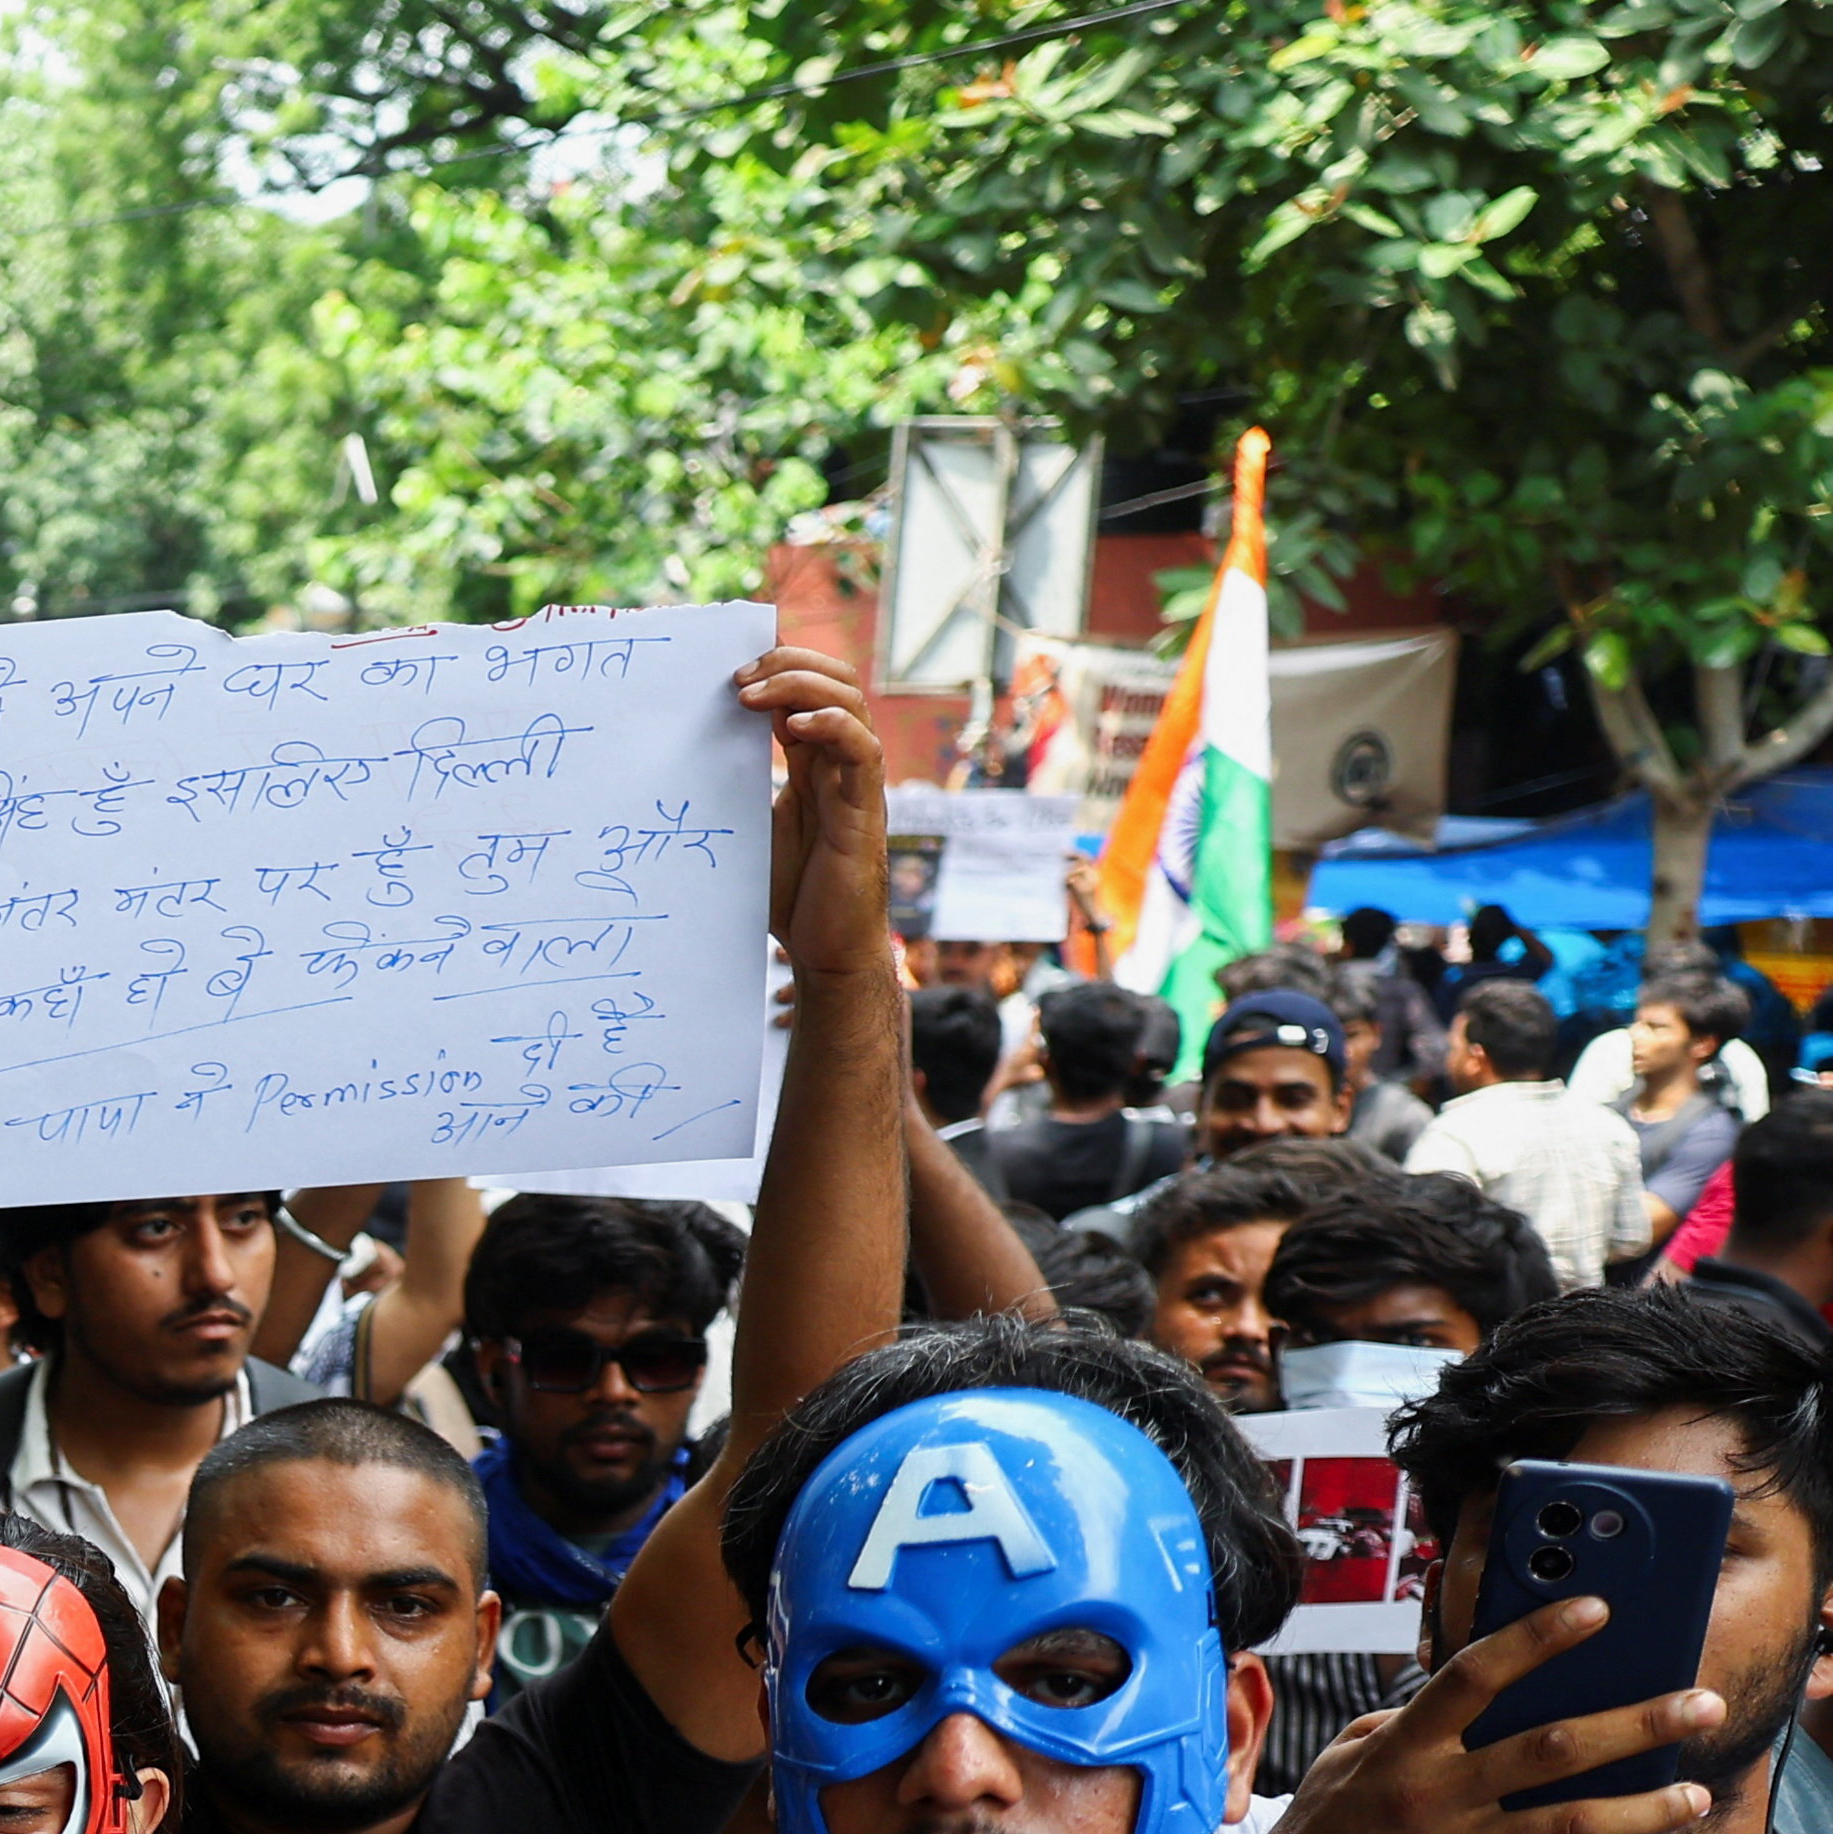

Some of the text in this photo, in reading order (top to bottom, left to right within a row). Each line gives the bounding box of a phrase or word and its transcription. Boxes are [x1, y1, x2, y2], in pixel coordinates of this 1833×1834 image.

[50, 644, 206, 740] अपने
[223, 660, 330, 711] घर
[360, 655, 459, 695] का
[485, 638, 672, 686] भगत
[393, 713, 595, 802] दिल्ली
[254, 862, 340, 906] पर
[458, 830, 572, 896] तुम
[125, 938, 188, 1031] हो
[480, 914, 670, 976] वाला
[4, 991, 666, 1145] पापा ने Permission दी है
[430, 1062, 682, 1148] आने की
[847, 1440, 1058, 1593] A
